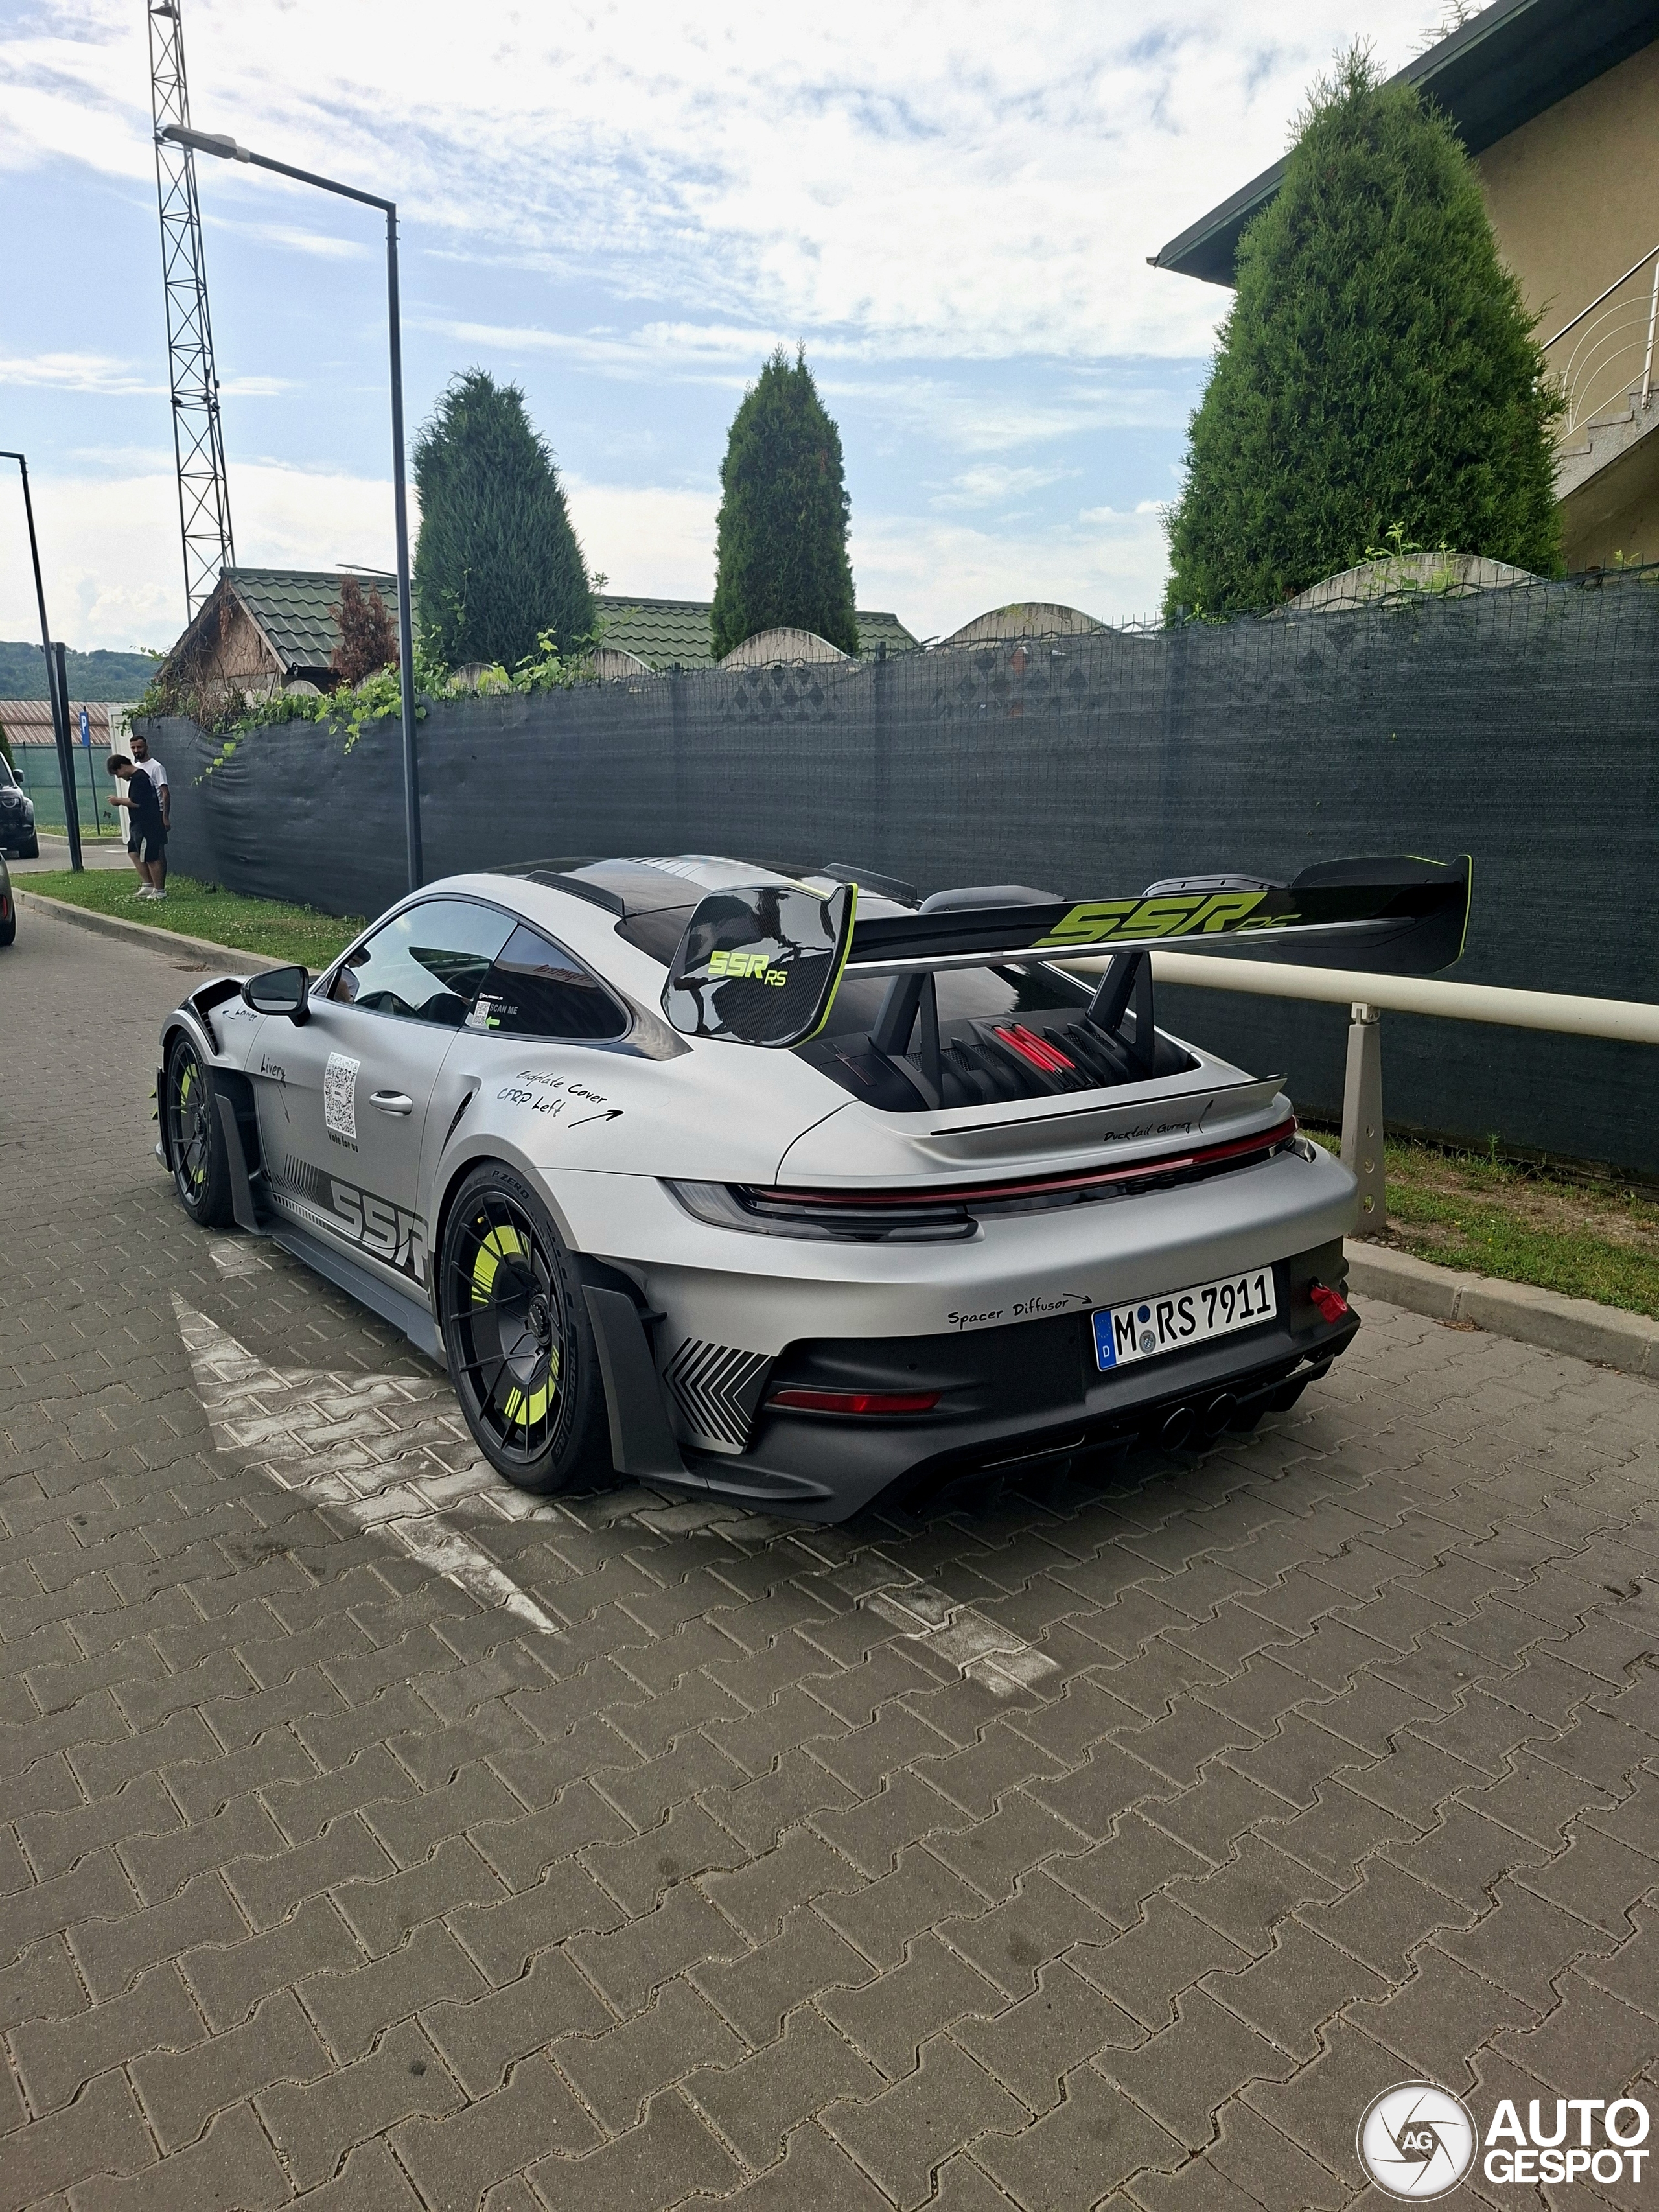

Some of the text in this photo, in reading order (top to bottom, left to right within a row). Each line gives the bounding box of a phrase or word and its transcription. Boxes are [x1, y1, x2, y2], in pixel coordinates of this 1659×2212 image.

[81, 715, 87, 734] P
[1029, 891, 1268, 948] SSR
[708, 950, 788, 986] SSR RS
[489, 1003, 518, 1014] SCAN ME
[261, 1053, 286, 1088] Livery
[497, 1088, 566, 1117] CFRP Left
[516, 1071, 608, 1104] Endplate Cover
[327, 1130, 358, 1153] Vote for us
[500, 1173, 530, 1199] ZERO
[331, 1180, 428, 1281] SSR
[947, 1297, 1069, 1330] Spacer Diffusor
[1102, 1345, 1109, 1358] D
